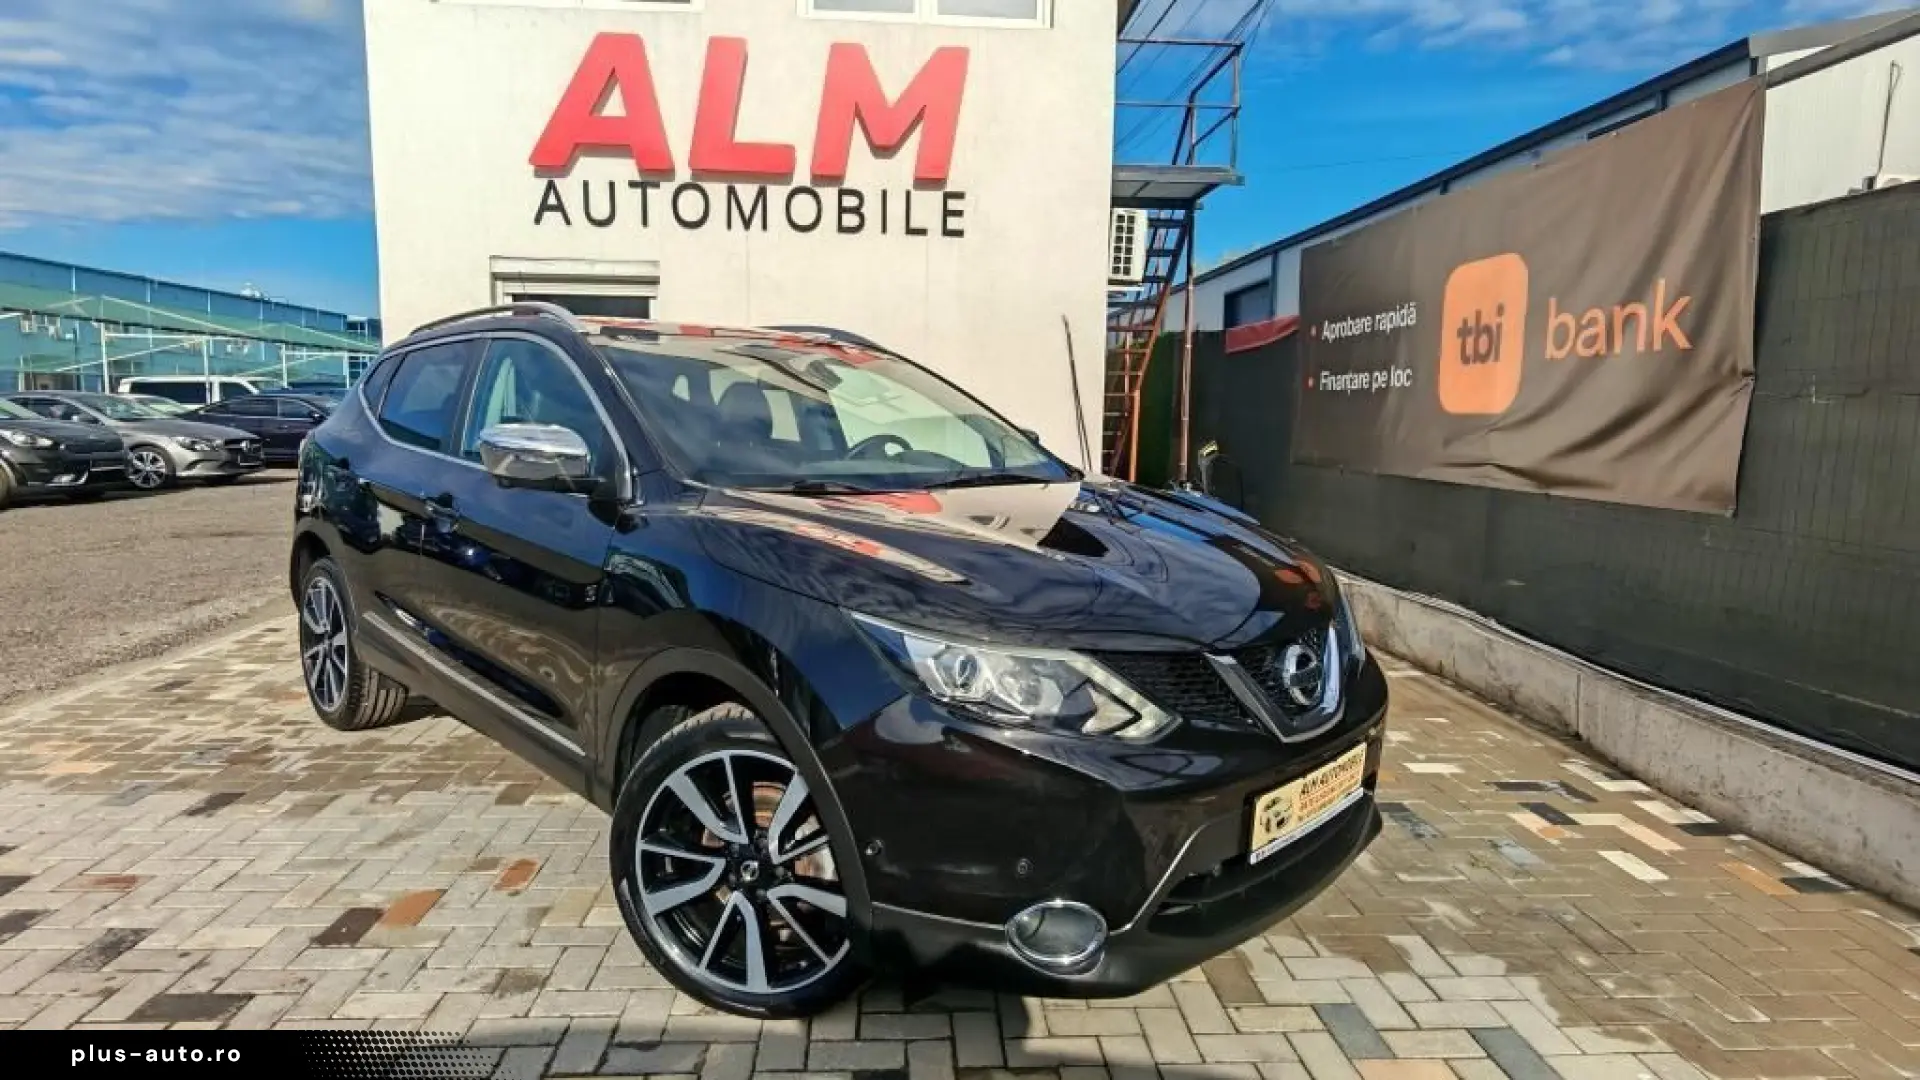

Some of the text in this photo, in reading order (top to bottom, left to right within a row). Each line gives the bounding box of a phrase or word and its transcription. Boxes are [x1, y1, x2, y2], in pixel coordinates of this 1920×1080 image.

[528, 32, 970, 180] ALM
[533, 179, 966, 238] AUTOMOBILE
[1322, 302, 1416, 343] Aprobare rapidă
[1457, 278, 1694, 365] tbi bank
[1372, 370, 1389, 394] pe
[1390, 365, 1412, 387] loc
